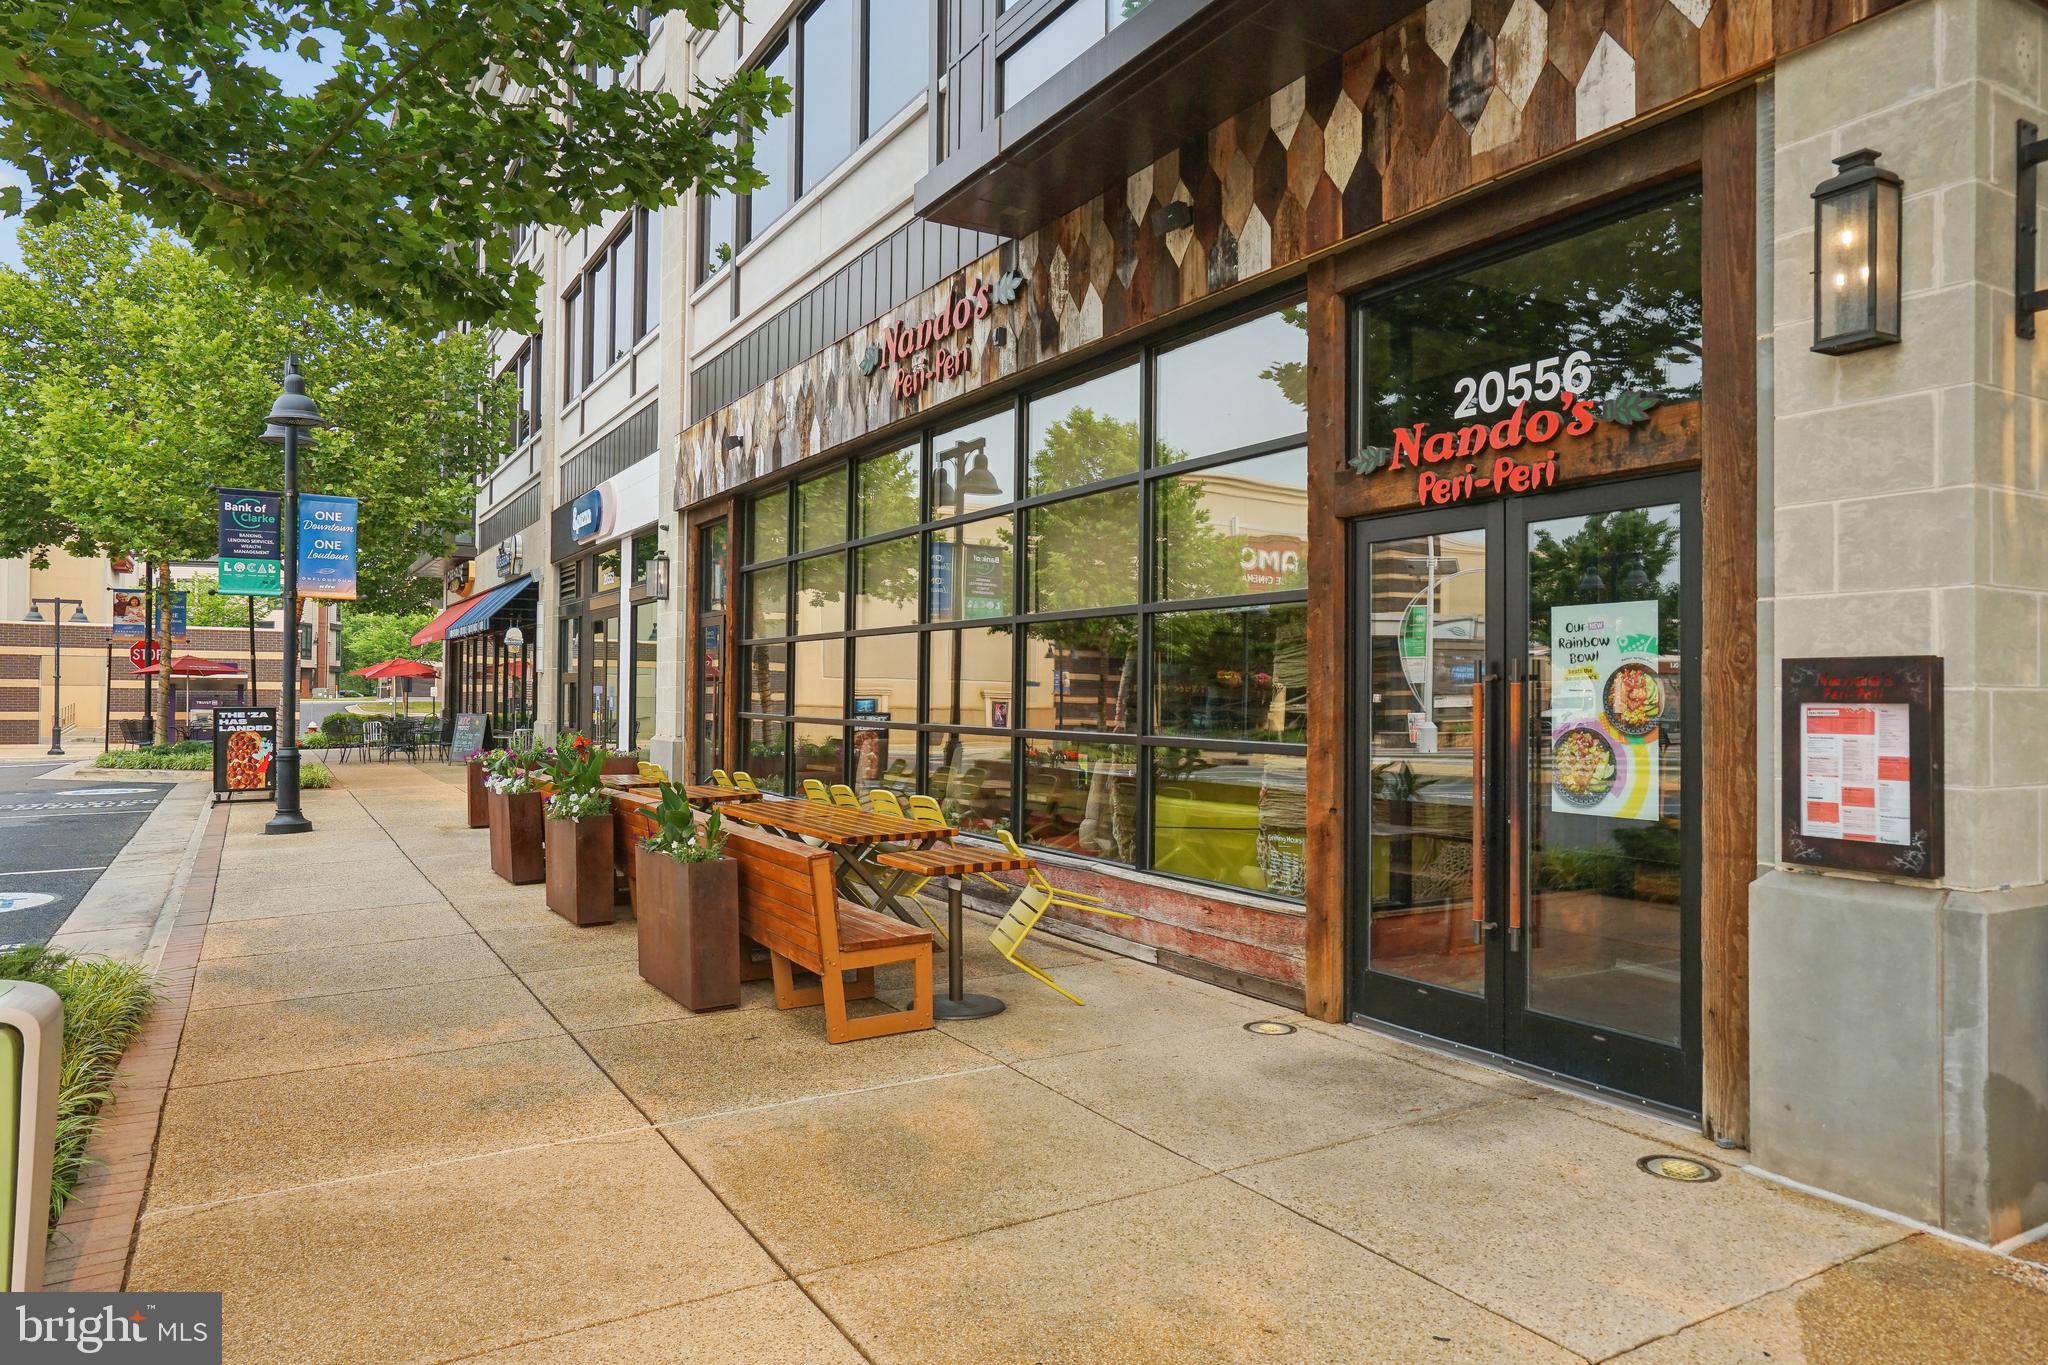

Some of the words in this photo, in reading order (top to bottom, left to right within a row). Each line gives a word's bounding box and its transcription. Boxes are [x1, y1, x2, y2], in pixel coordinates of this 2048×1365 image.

[880, 278, 990, 370] Nando's
[895, 337, 972, 400] Peri-Peri
[1453, 350, 1592, 420] 20556
[1388, 390, 1595, 472] Nando's
[1418, 450, 1557, 506] Peri-Peri
[224, 501, 251, 512] Bank
[254, 504, 266, 513] of
[240, 513, 276, 524] Clarke
[315, 511, 342, 521] ONE
[303, 520, 354, 533] Downtown
[314, 539, 342, 550] ONE
[307, 549, 349, 560] Loudoun
[223, 561, 276, 574] LOCAL
[1565, 622, 1585, 633] Our
